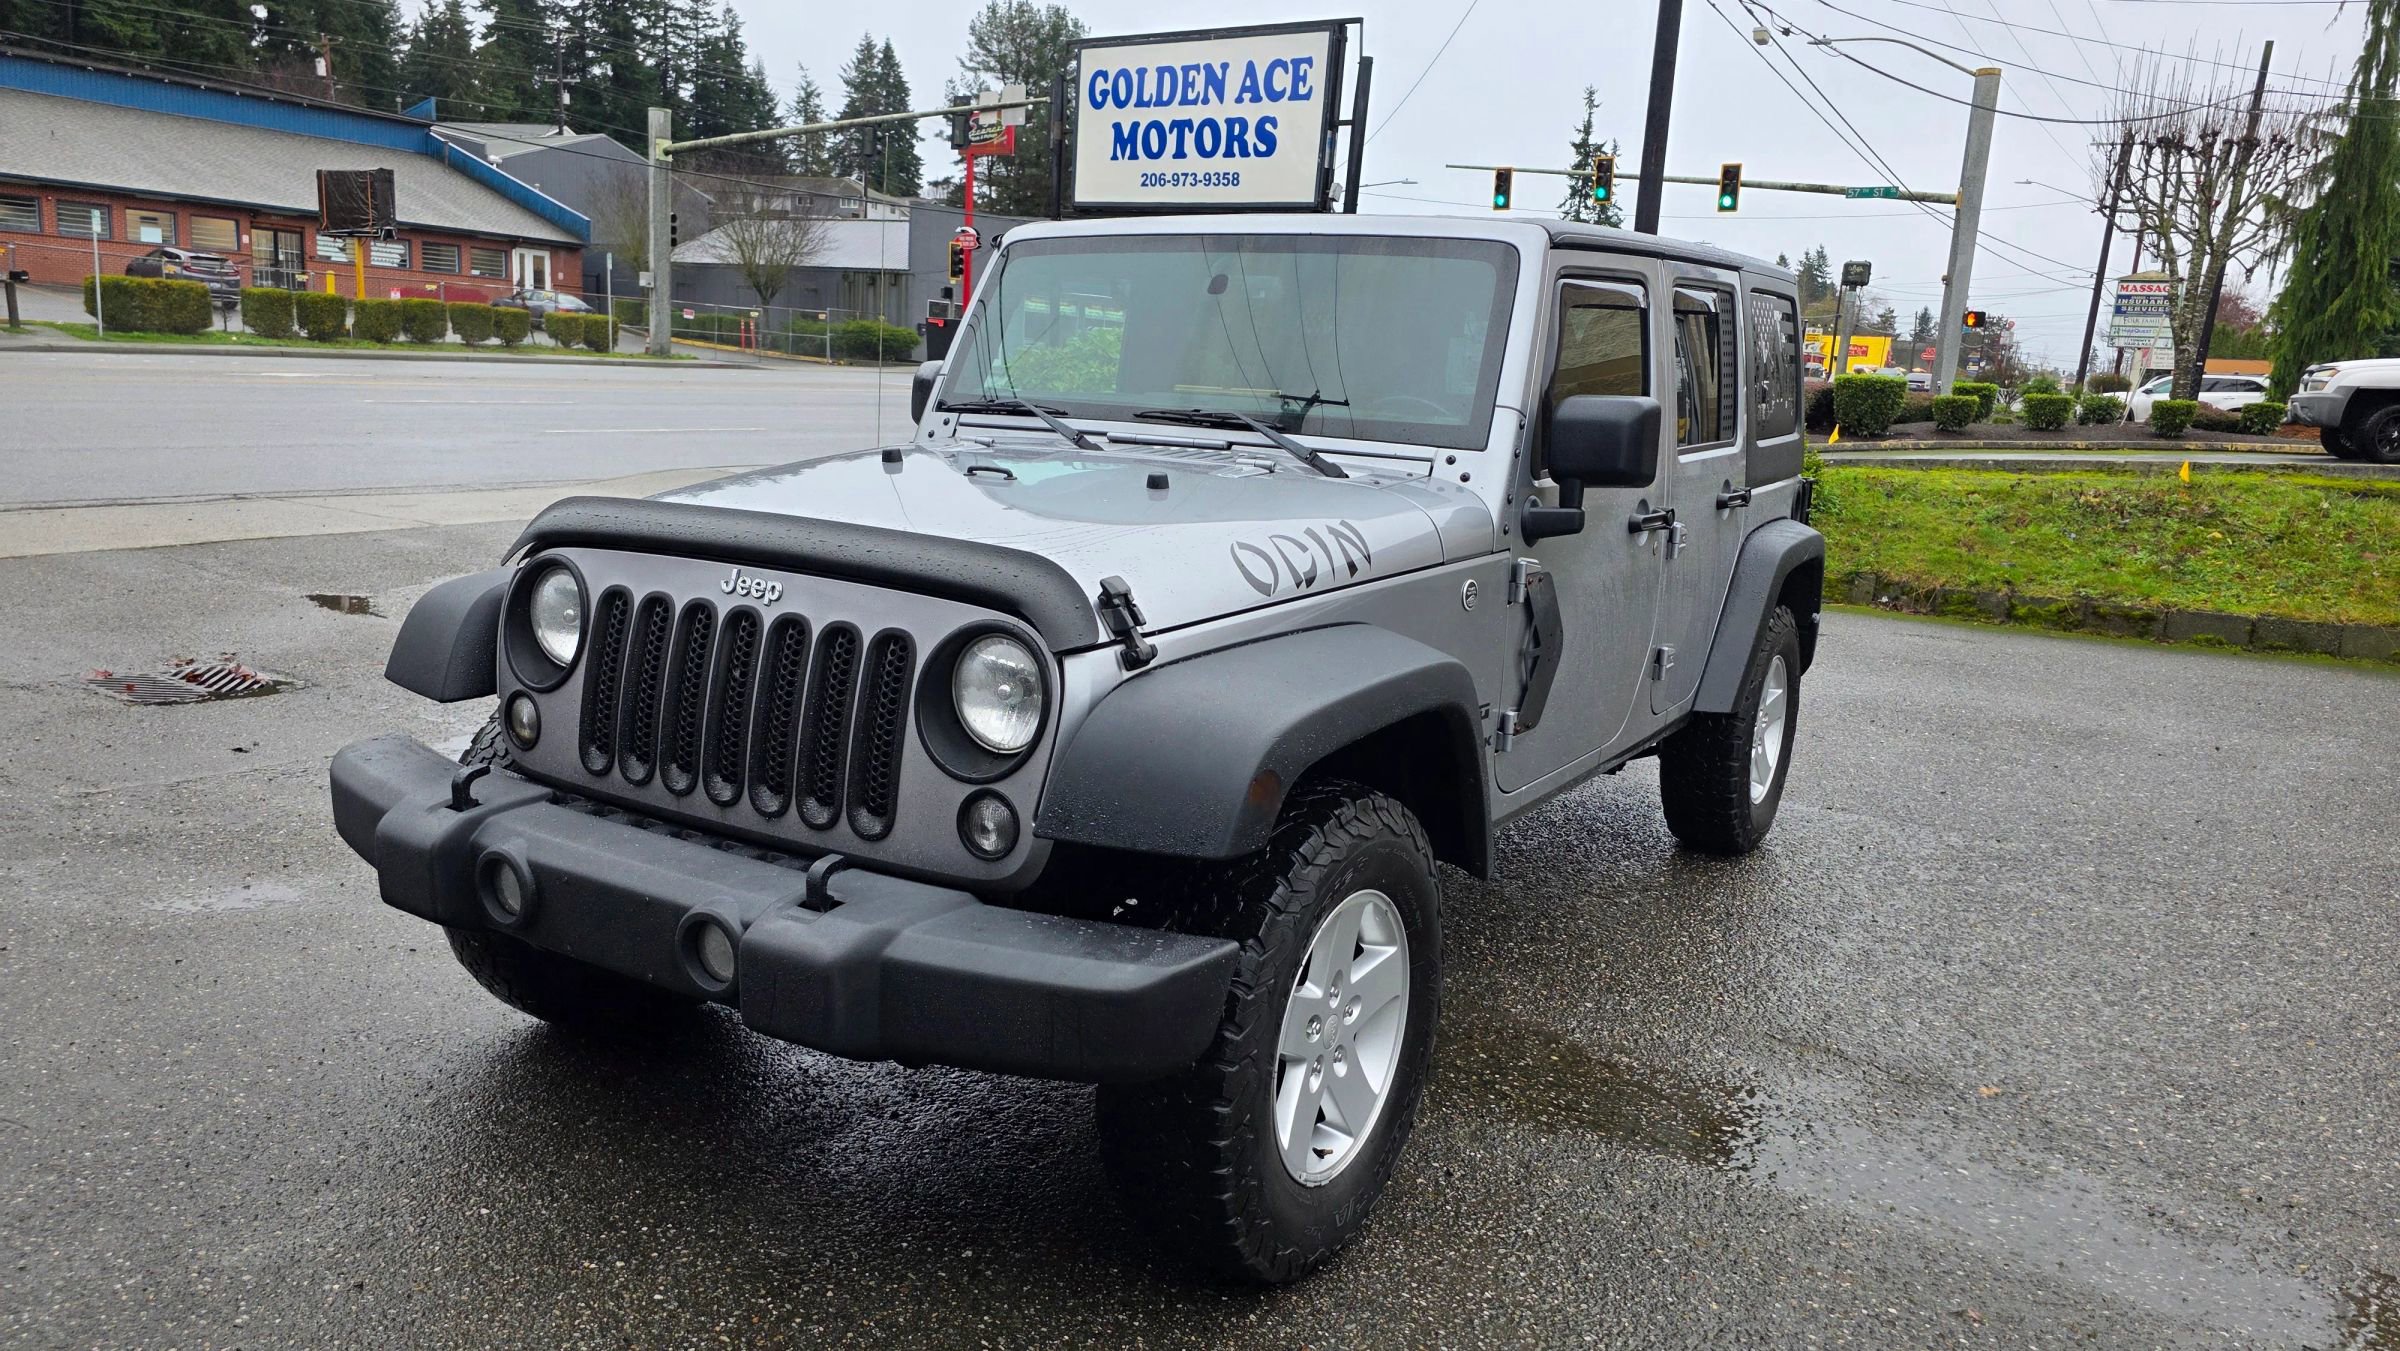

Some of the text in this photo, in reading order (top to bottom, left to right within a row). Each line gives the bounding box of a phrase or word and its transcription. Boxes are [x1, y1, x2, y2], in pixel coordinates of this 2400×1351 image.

[1088, 56, 1313, 110] GOLDEN ACE
[1110, 115, 1279, 161] MOTORS
[1140, 172, 1240, 187] 206-973-9358
[2120, 284, 2170, 292] MASSAG
[1230, 519, 1372, 598] ODIN
[720, 568, 783, 607] Jeep
